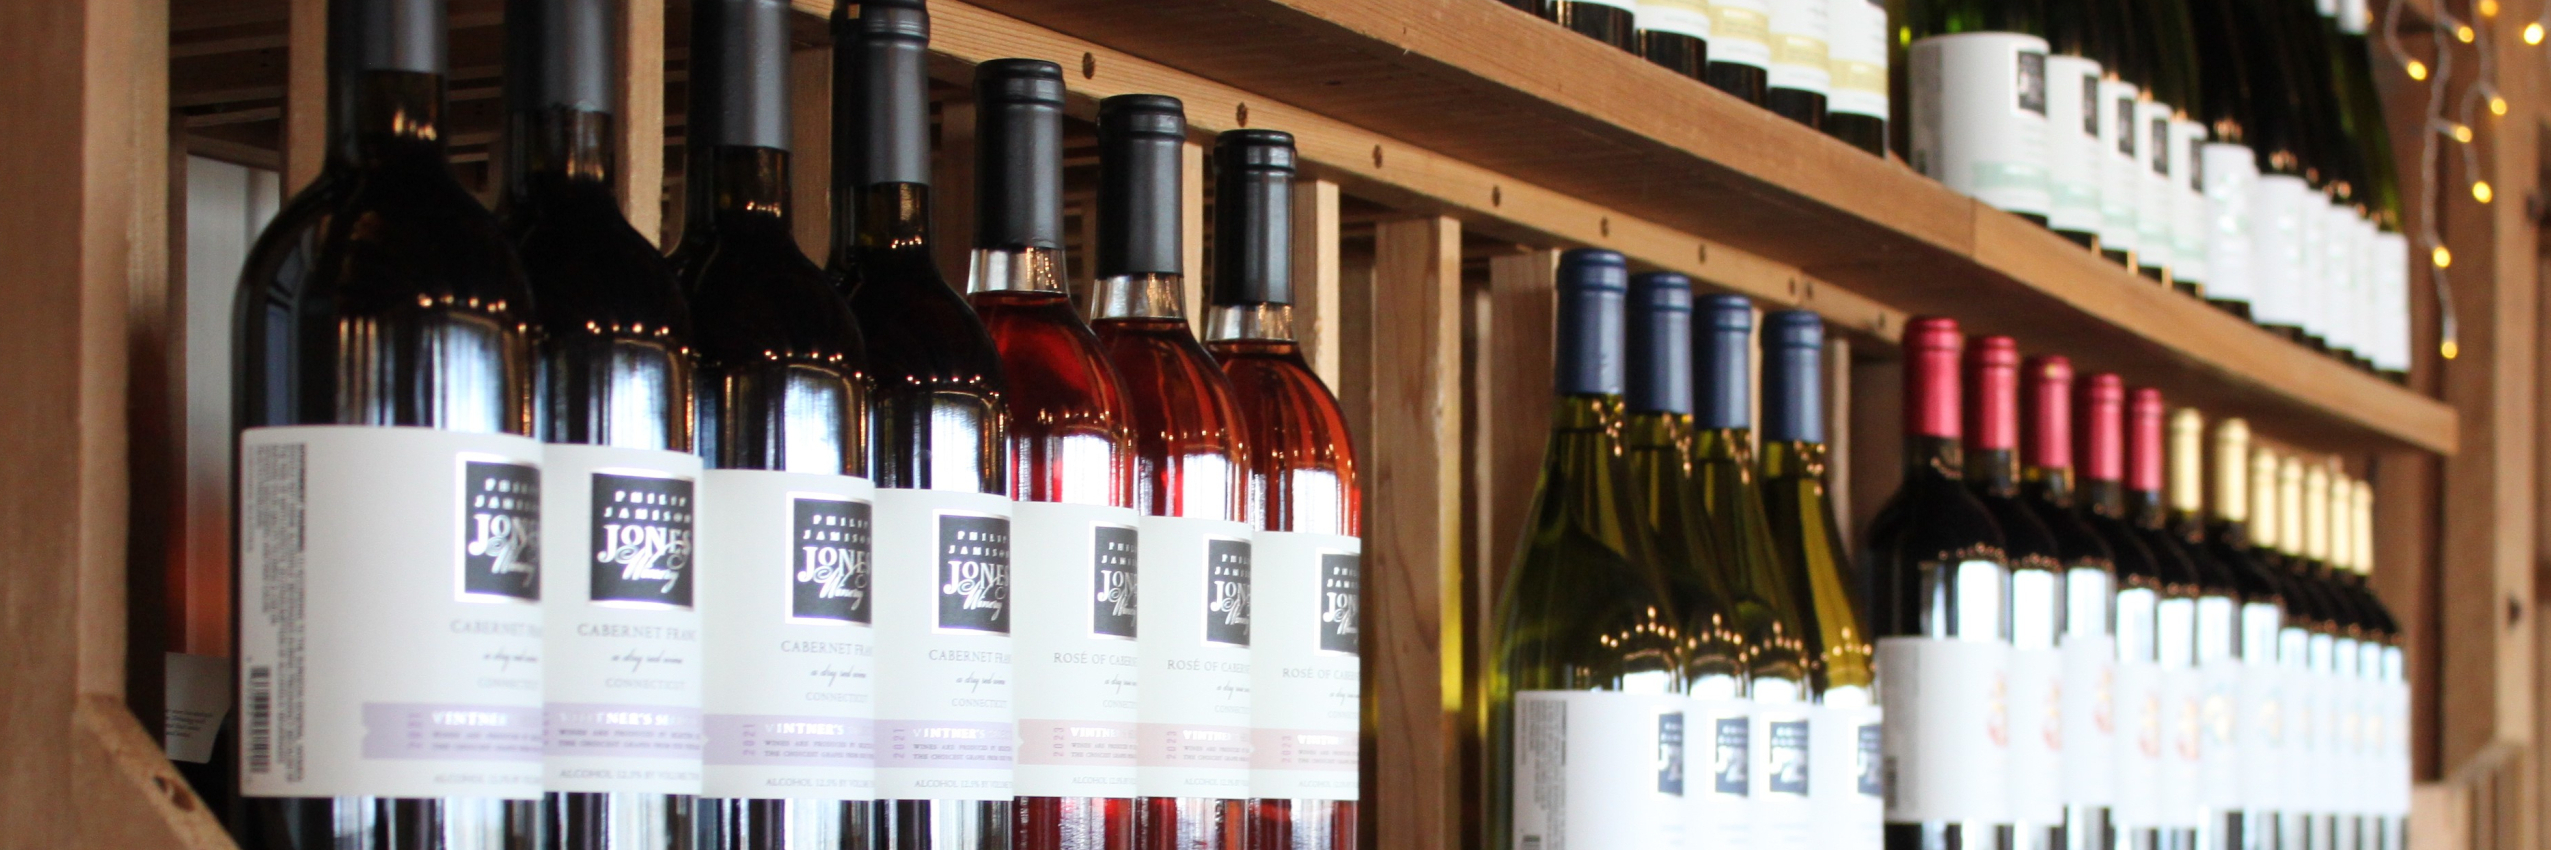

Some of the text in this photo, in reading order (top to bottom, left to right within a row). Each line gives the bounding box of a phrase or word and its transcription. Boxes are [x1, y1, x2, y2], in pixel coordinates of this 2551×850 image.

[615, 490, 687, 507] PHILIP
[813, 514, 869, 529] PHILIP
[597, 523, 692, 563] JONES
[1108, 541, 1137, 553] PHIL
[1221, 553, 1249, 565] PHIL
[1097, 569, 1137, 602] JON
[1210, 580, 1250, 612] JON
[577, 622, 662, 639] CABERNET
[780, 640, 852, 656] CABERNET
[928, 649, 994, 663] CABERNET
[1053, 650, 1088, 664] ROSÉ
[1091, 653, 1107, 665] OF
[1167, 657, 1201, 671] ROSÉ
[1203, 660, 1219, 672] OF
[1282, 666, 1314, 679] ROSÉ
[1317, 669, 1331, 679] OF
[764, 722, 845, 736] VINTNER'S
[912, 727, 986, 740] VINTNER'S
[1070, 727, 1117, 738] VINTNE
[766, 778, 813, 787] ALCOHOL
[914, 779, 959, 789] ALCOHOL
[1071, 776, 1108, 785] ALCOHOL
